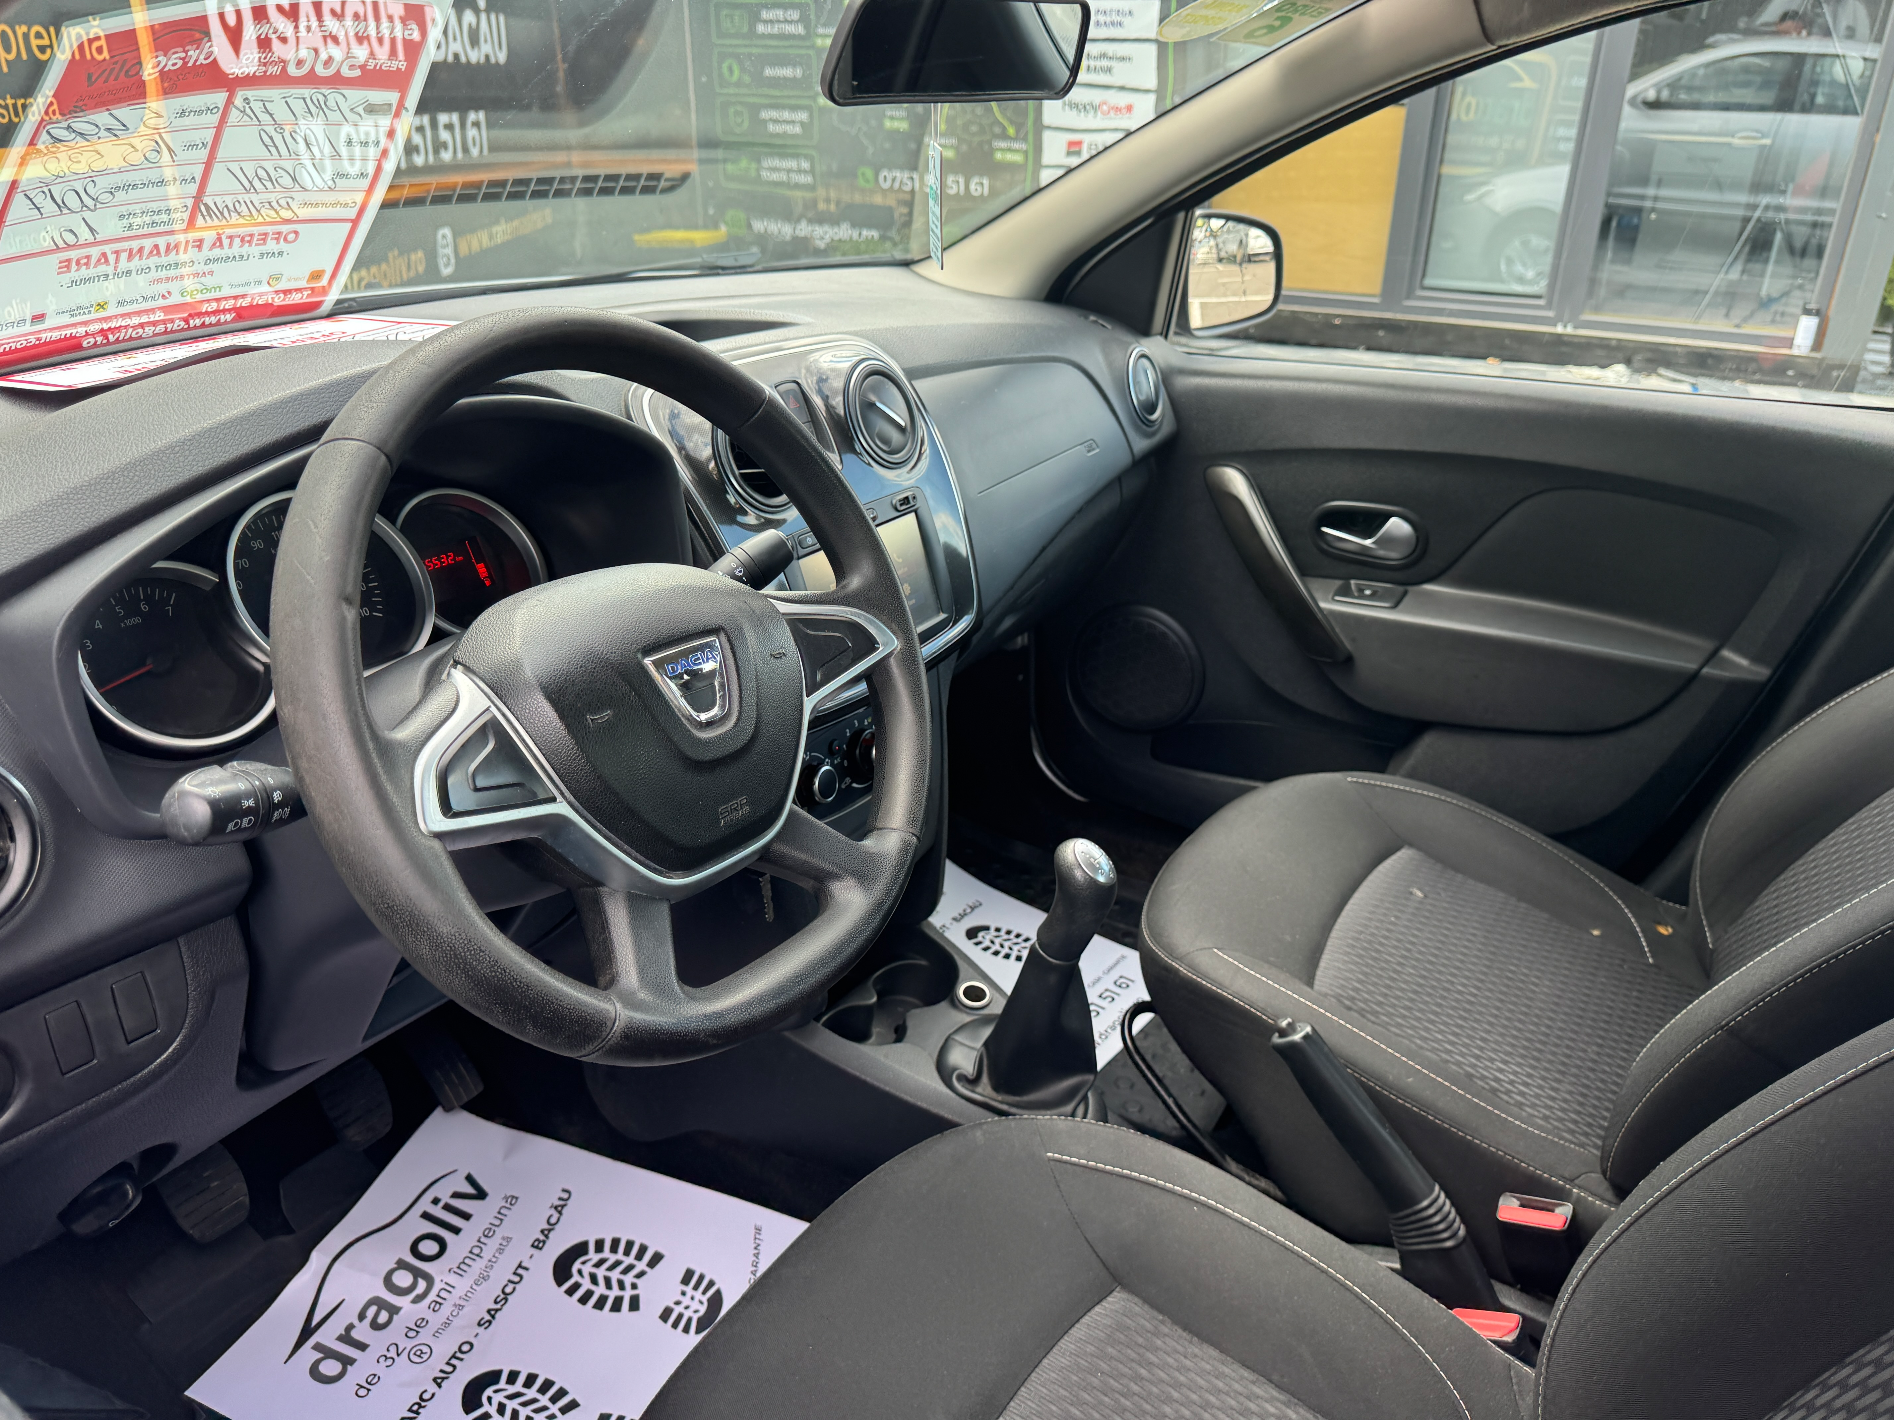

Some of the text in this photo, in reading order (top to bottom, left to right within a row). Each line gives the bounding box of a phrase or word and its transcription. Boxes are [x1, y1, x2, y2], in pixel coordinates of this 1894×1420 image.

[411, 114, 434, 167] 51
[437, 112, 463, 162] 51
[466, 110, 489, 158] 61
[878, 168, 919, 192] 0751
[946, 174, 965, 196] 51
[969, 175, 990, 197] 61
[250, 539, 264, 551] 90
[235, 558, 250, 570] 70
[115, 605, 124, 616] 5
[140, 601, 149, 612] 6
[164, 606, 173, 617] 7
[94, 620, 103, 630] 4
[120, 616, 142, 628] x1000
[83, 639, 93, 650] 3
[665, 648, 719, 677] DACIA
[1098, 988, 1121, 1003] 51
[1113, 975, 1135, 989] 61
[308, 1171, 489, 1385] dragoliv
[432, 1339, 475, 1389] AUTO
[476, 1259, 531, 1331] SASCUT
[530, 1187, 573, 1252] BACĂU
[354, 1192, 519, 1399] de 32 de ani împreună
